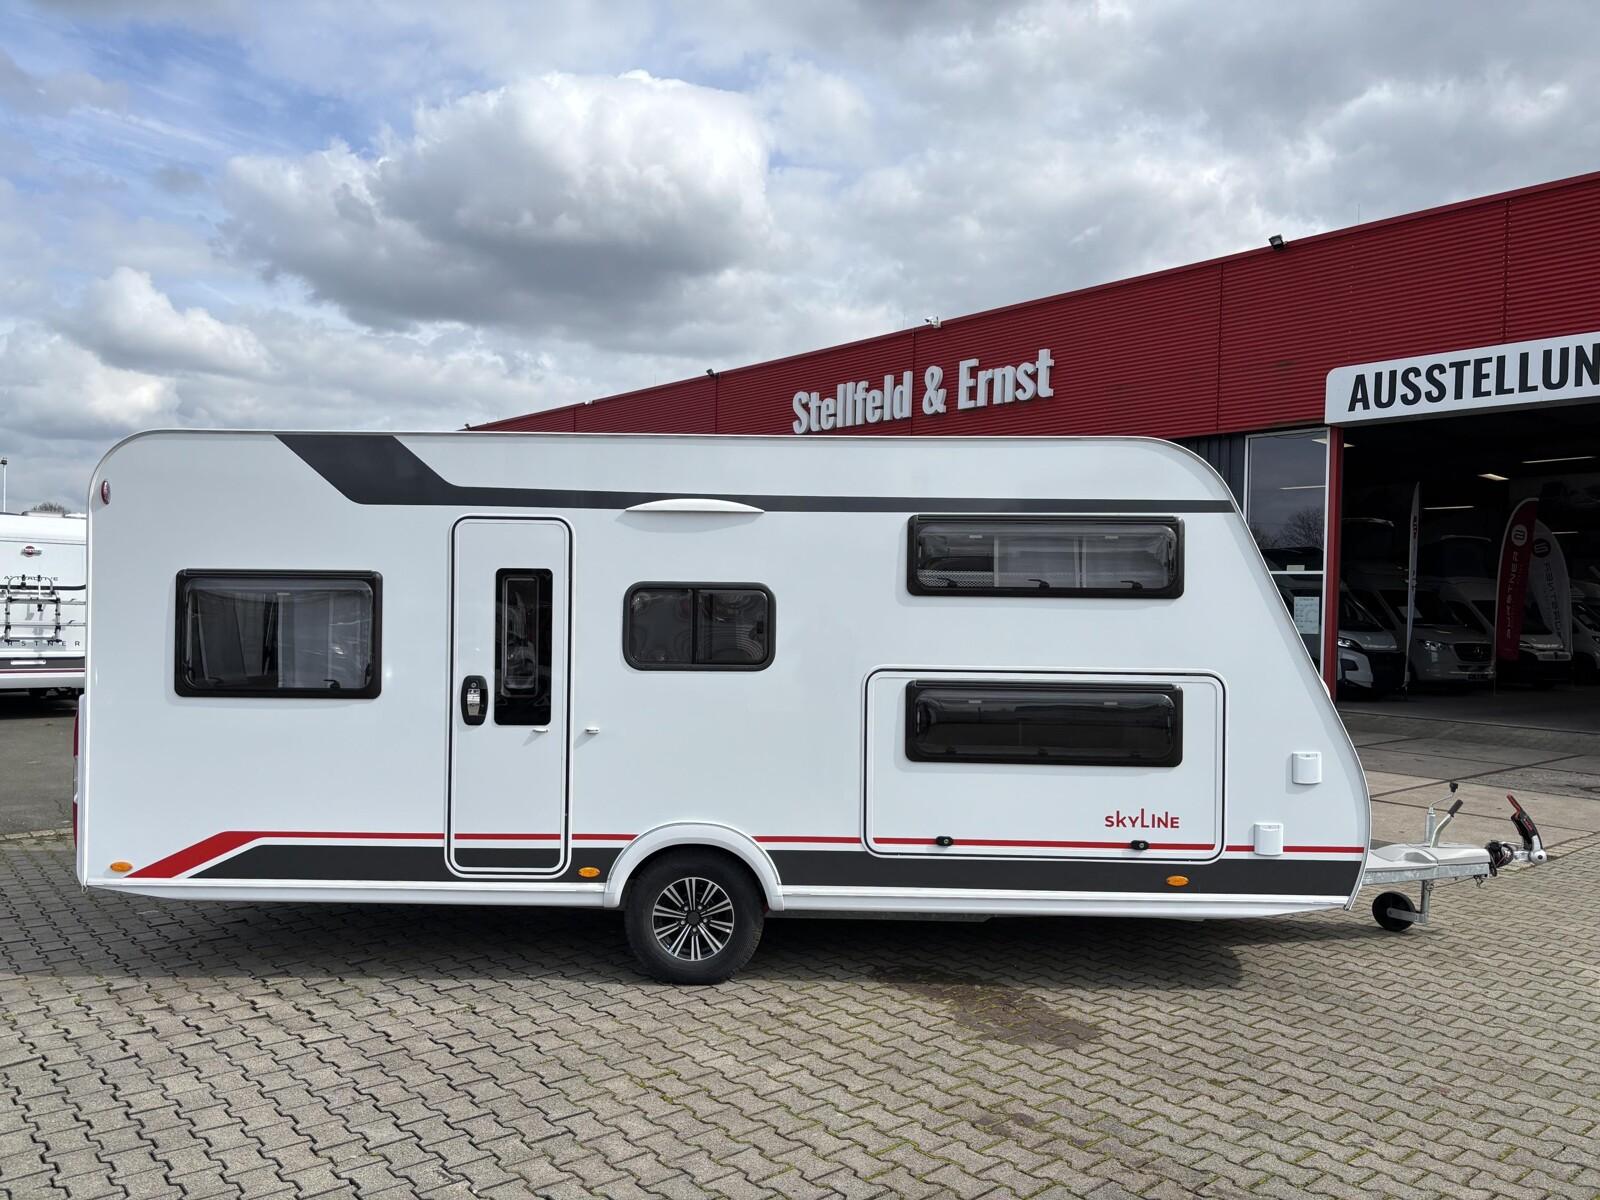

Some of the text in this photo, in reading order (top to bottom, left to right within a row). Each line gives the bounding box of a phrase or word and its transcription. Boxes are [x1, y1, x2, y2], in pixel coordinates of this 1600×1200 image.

[792, 348, 1055, 434] Stellfeld & Ernst
